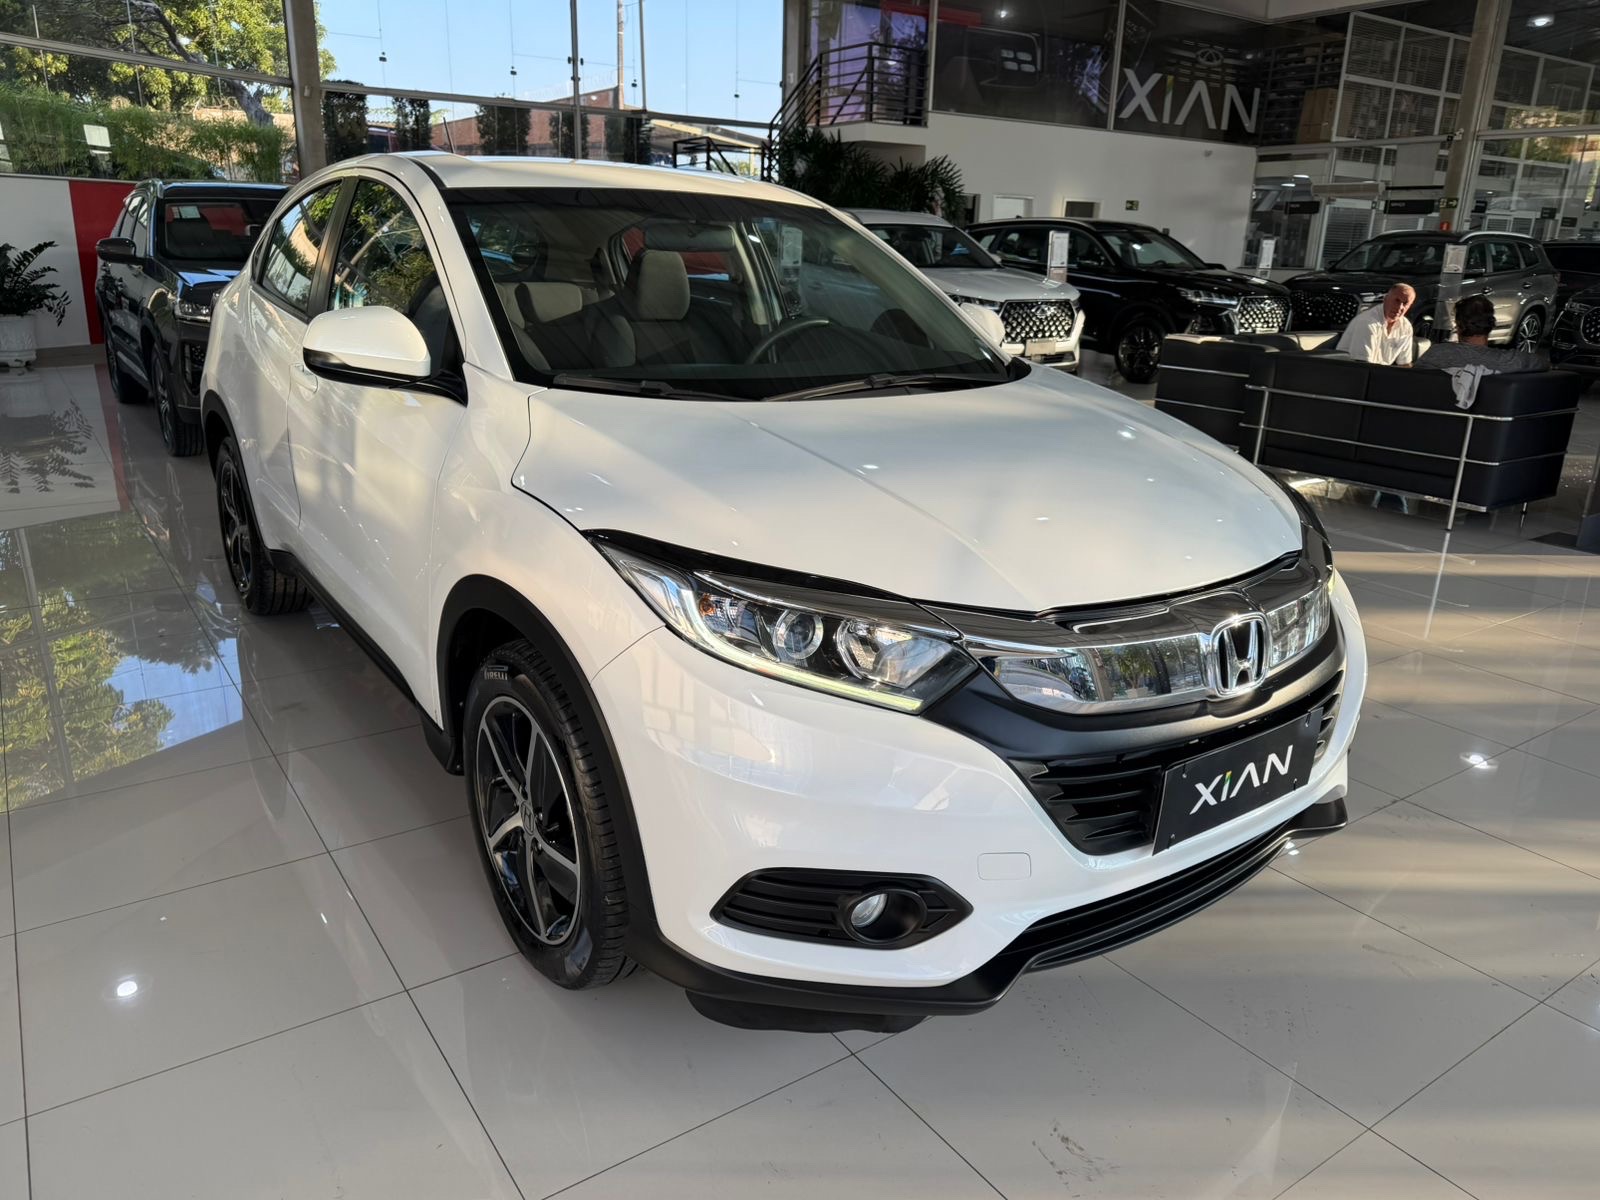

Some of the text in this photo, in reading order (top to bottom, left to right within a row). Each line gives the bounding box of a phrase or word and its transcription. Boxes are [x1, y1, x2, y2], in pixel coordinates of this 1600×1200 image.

[1118, 68, 1261, 133] XIAN
[484, 665, 509, 681] PIRELLI
[1189, 744, 1294, 815] XIAN
